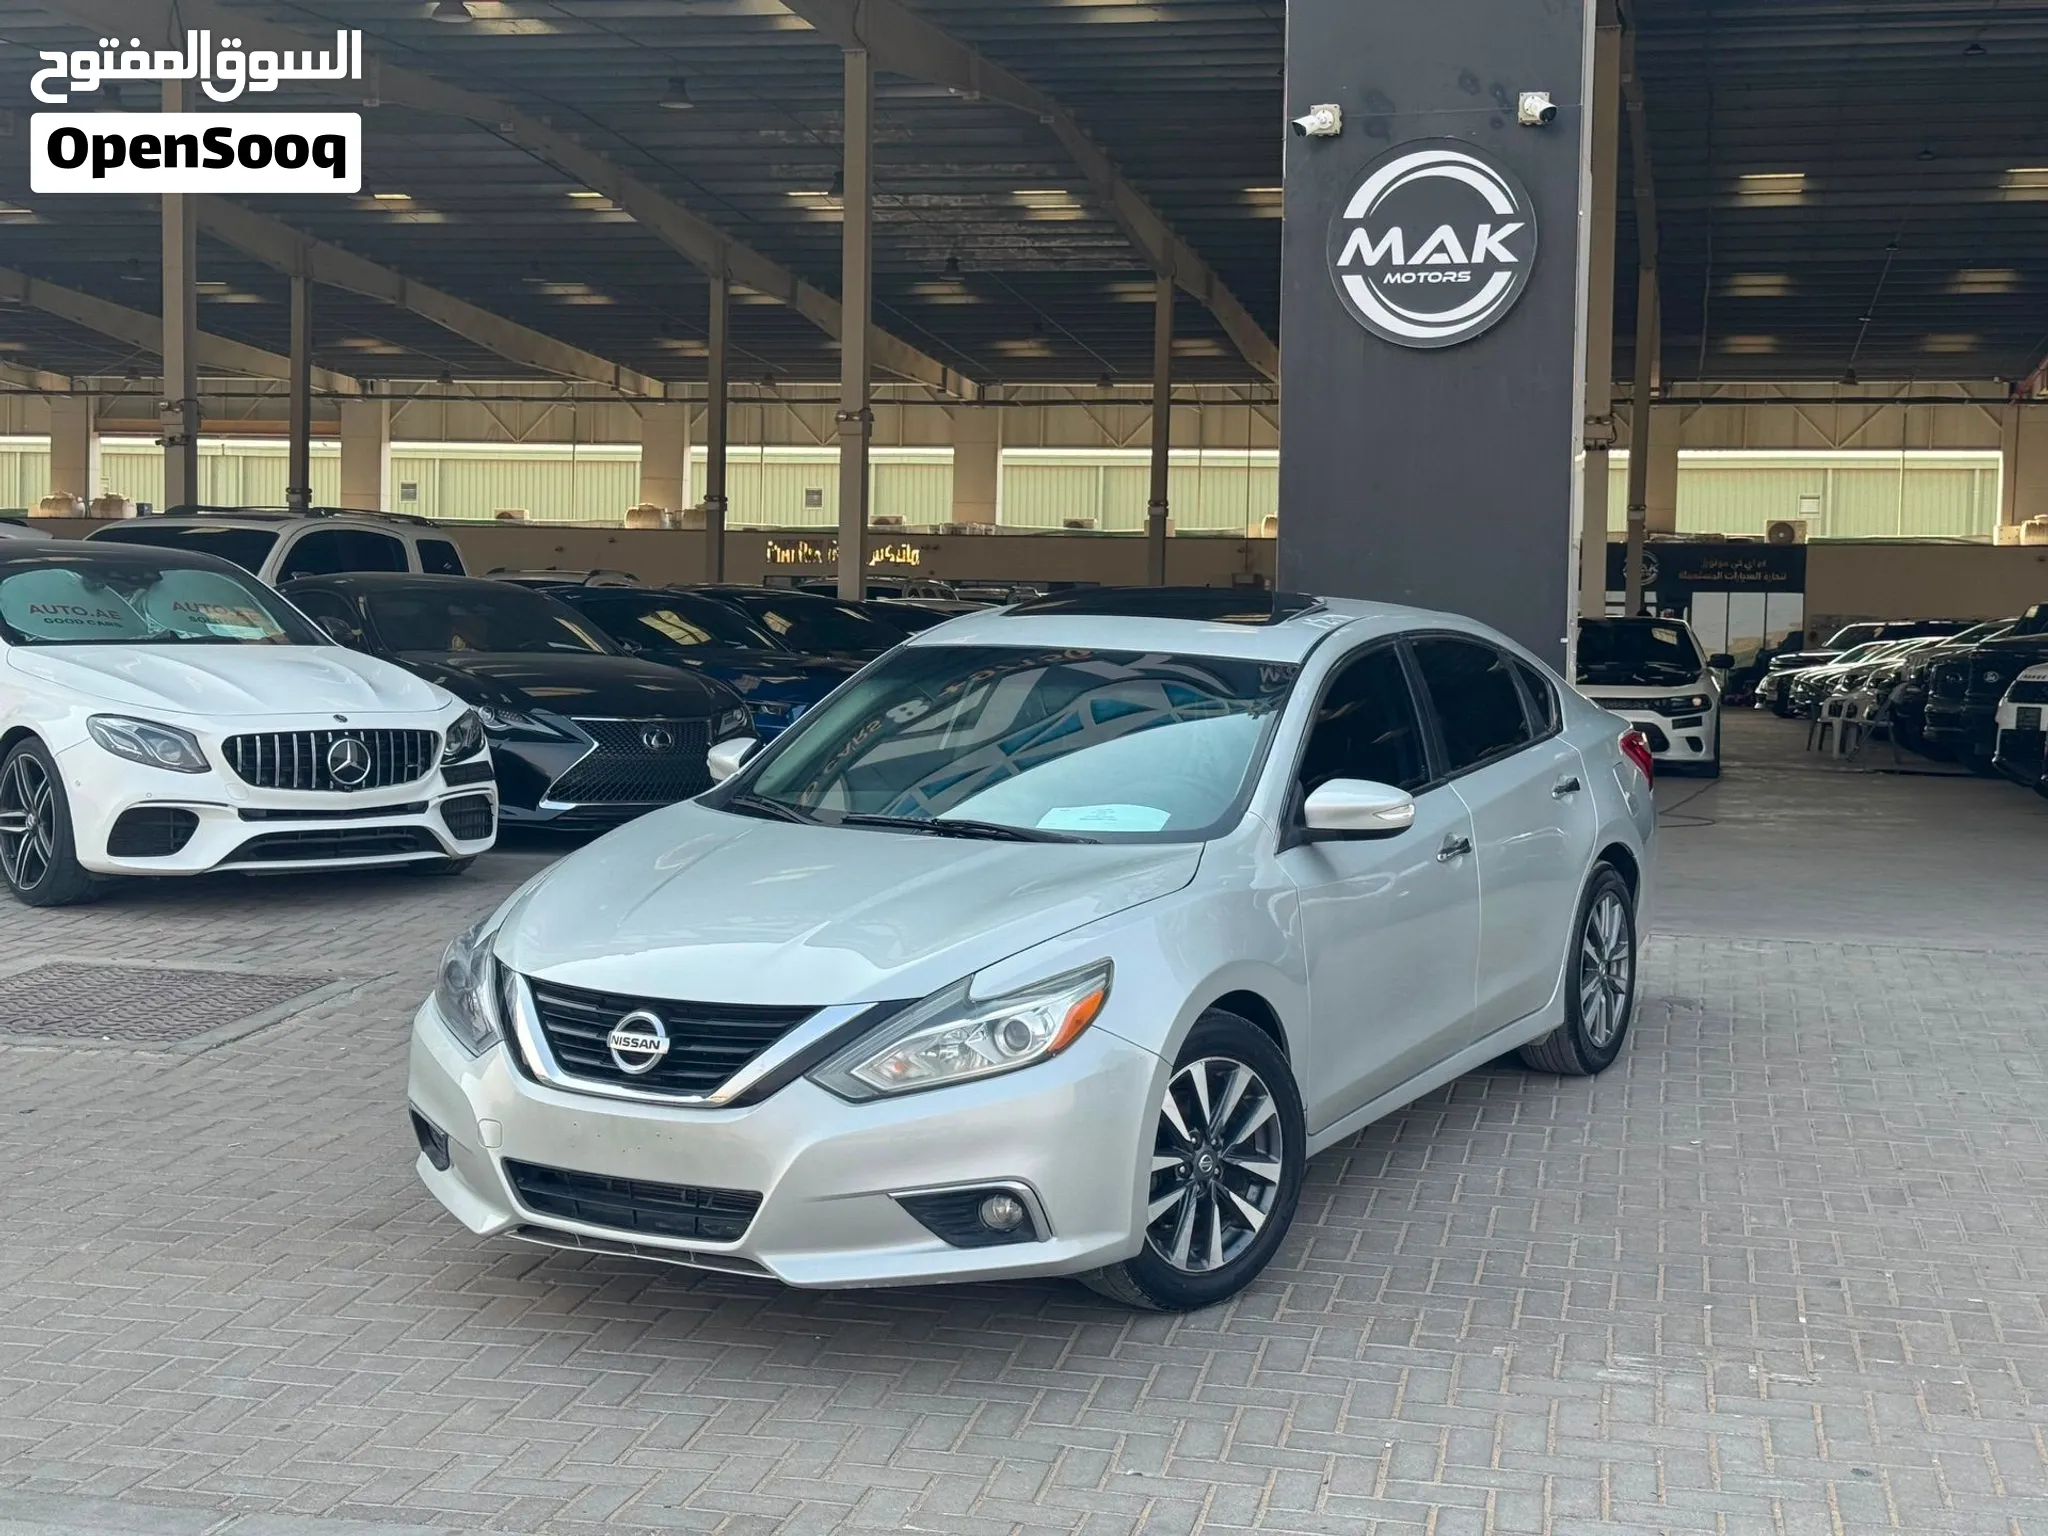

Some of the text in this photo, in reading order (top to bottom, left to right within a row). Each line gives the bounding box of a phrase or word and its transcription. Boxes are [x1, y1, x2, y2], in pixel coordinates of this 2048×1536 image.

[1336, 222, 1526, 266] MAK
[1383, 270, 1472, 284] MOTORS
[29, 604, 122, 621] AUTO.AE
[43, 617, 84, 625] GOOD
[611, 1034, 661, 1051] NISSAN
